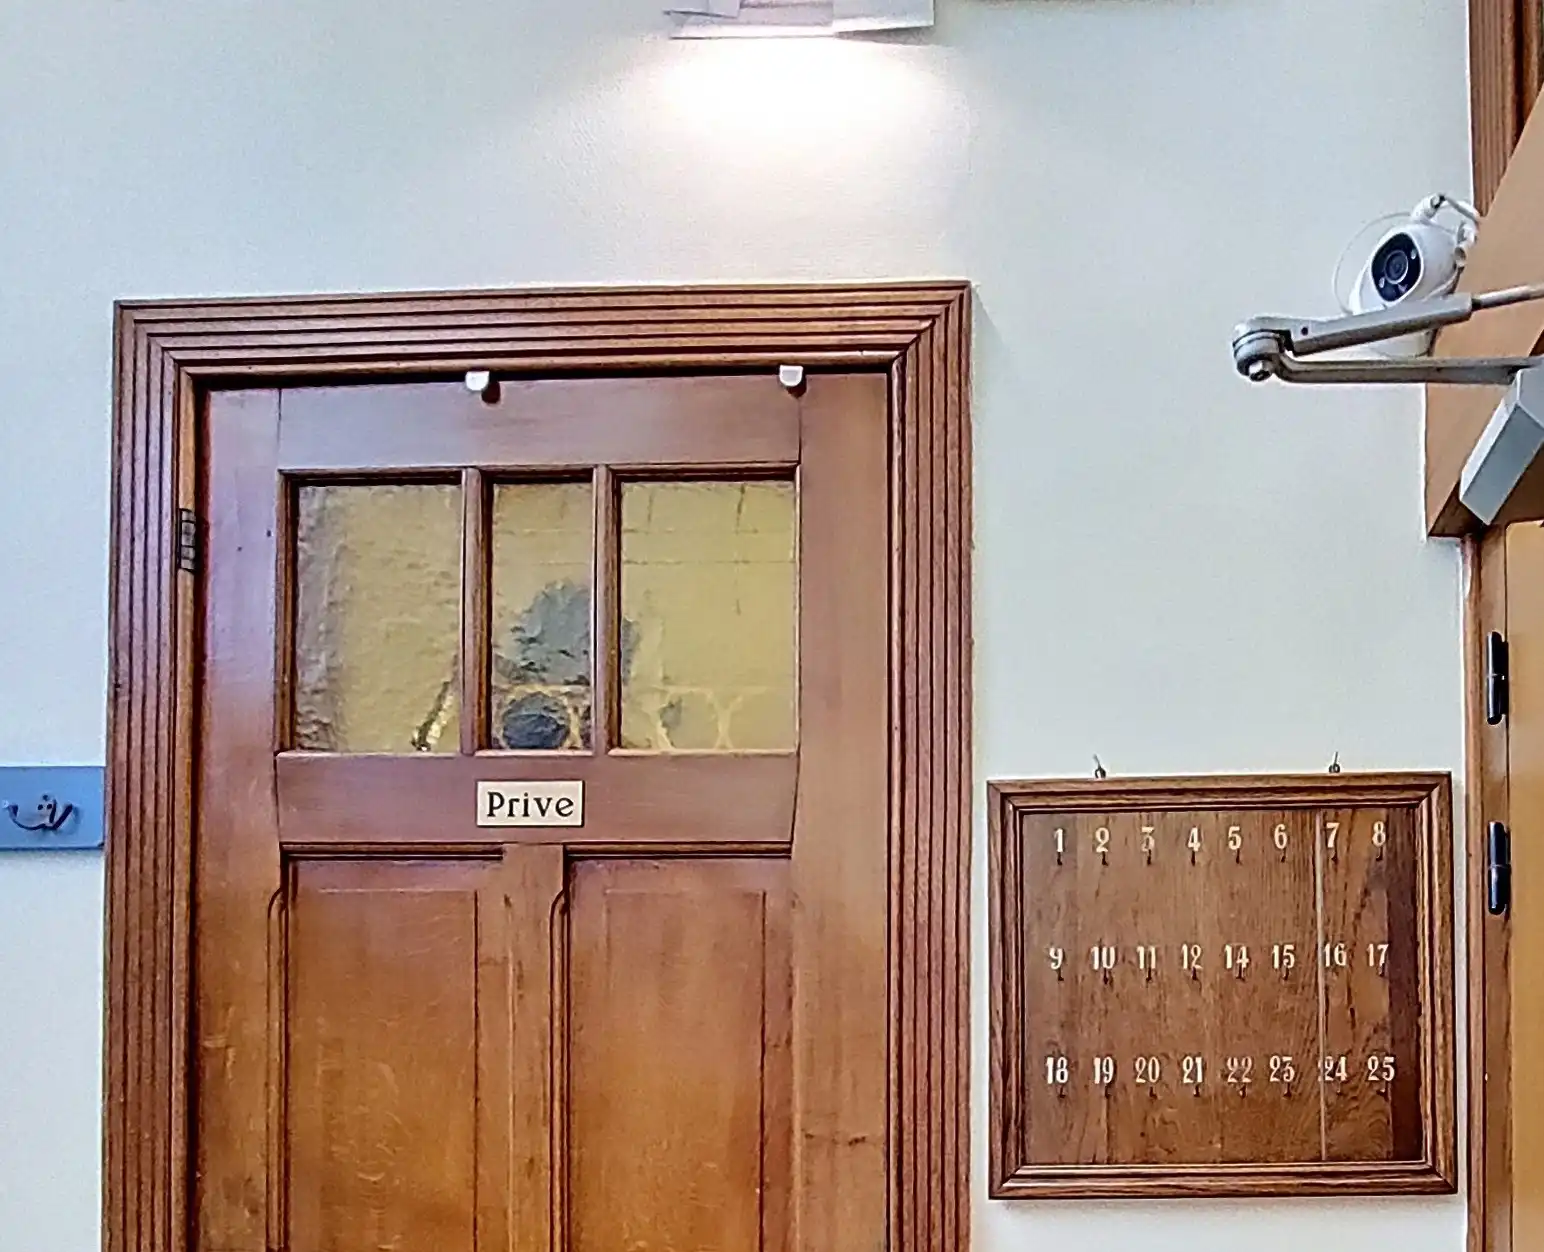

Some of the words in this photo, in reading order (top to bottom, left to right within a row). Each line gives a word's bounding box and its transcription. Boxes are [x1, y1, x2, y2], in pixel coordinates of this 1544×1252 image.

[487, 791, 574, 817] Prive
[1053, 828, 1064, 852] 1
[1095, 827, 1110, 853] 2
[1141, 826, 1155, 852] 3
[1187, 826, 1201, 852] 4
[1228, 826, 1242, 850] 5
[1274, 824, 1288, 849] 6
[1326, 822, 1340, 848] 7
[1372, 821, 1386, 846] 8
[1049, 947, 1063, 970] 9
[1091, 946, 1115, 970] 10
[1136, 946, 1156, 969] 11
[1181, 944, 1203, 969] 12
[1224, 944, 1249, 969] 14
[1272, 944, 1295, 969] 15
[1323, 943, 1347, 967] 16
[1367, 943, 1389, 968] 17
[1045, 1056, 1069, 1084] 18
[1093, 1056, 1114, 1084] 19
[1135, 1056, 1160, 1084] 20
[1182, 1056, 1203, 1084] 21
[1227, 1056, 1252, 1083] 22
[1269, 1055, 1295, 1082] 23
[1318, 1056, 1347, 1082] 24
[1367, 1056, 1395, 1081] 25
